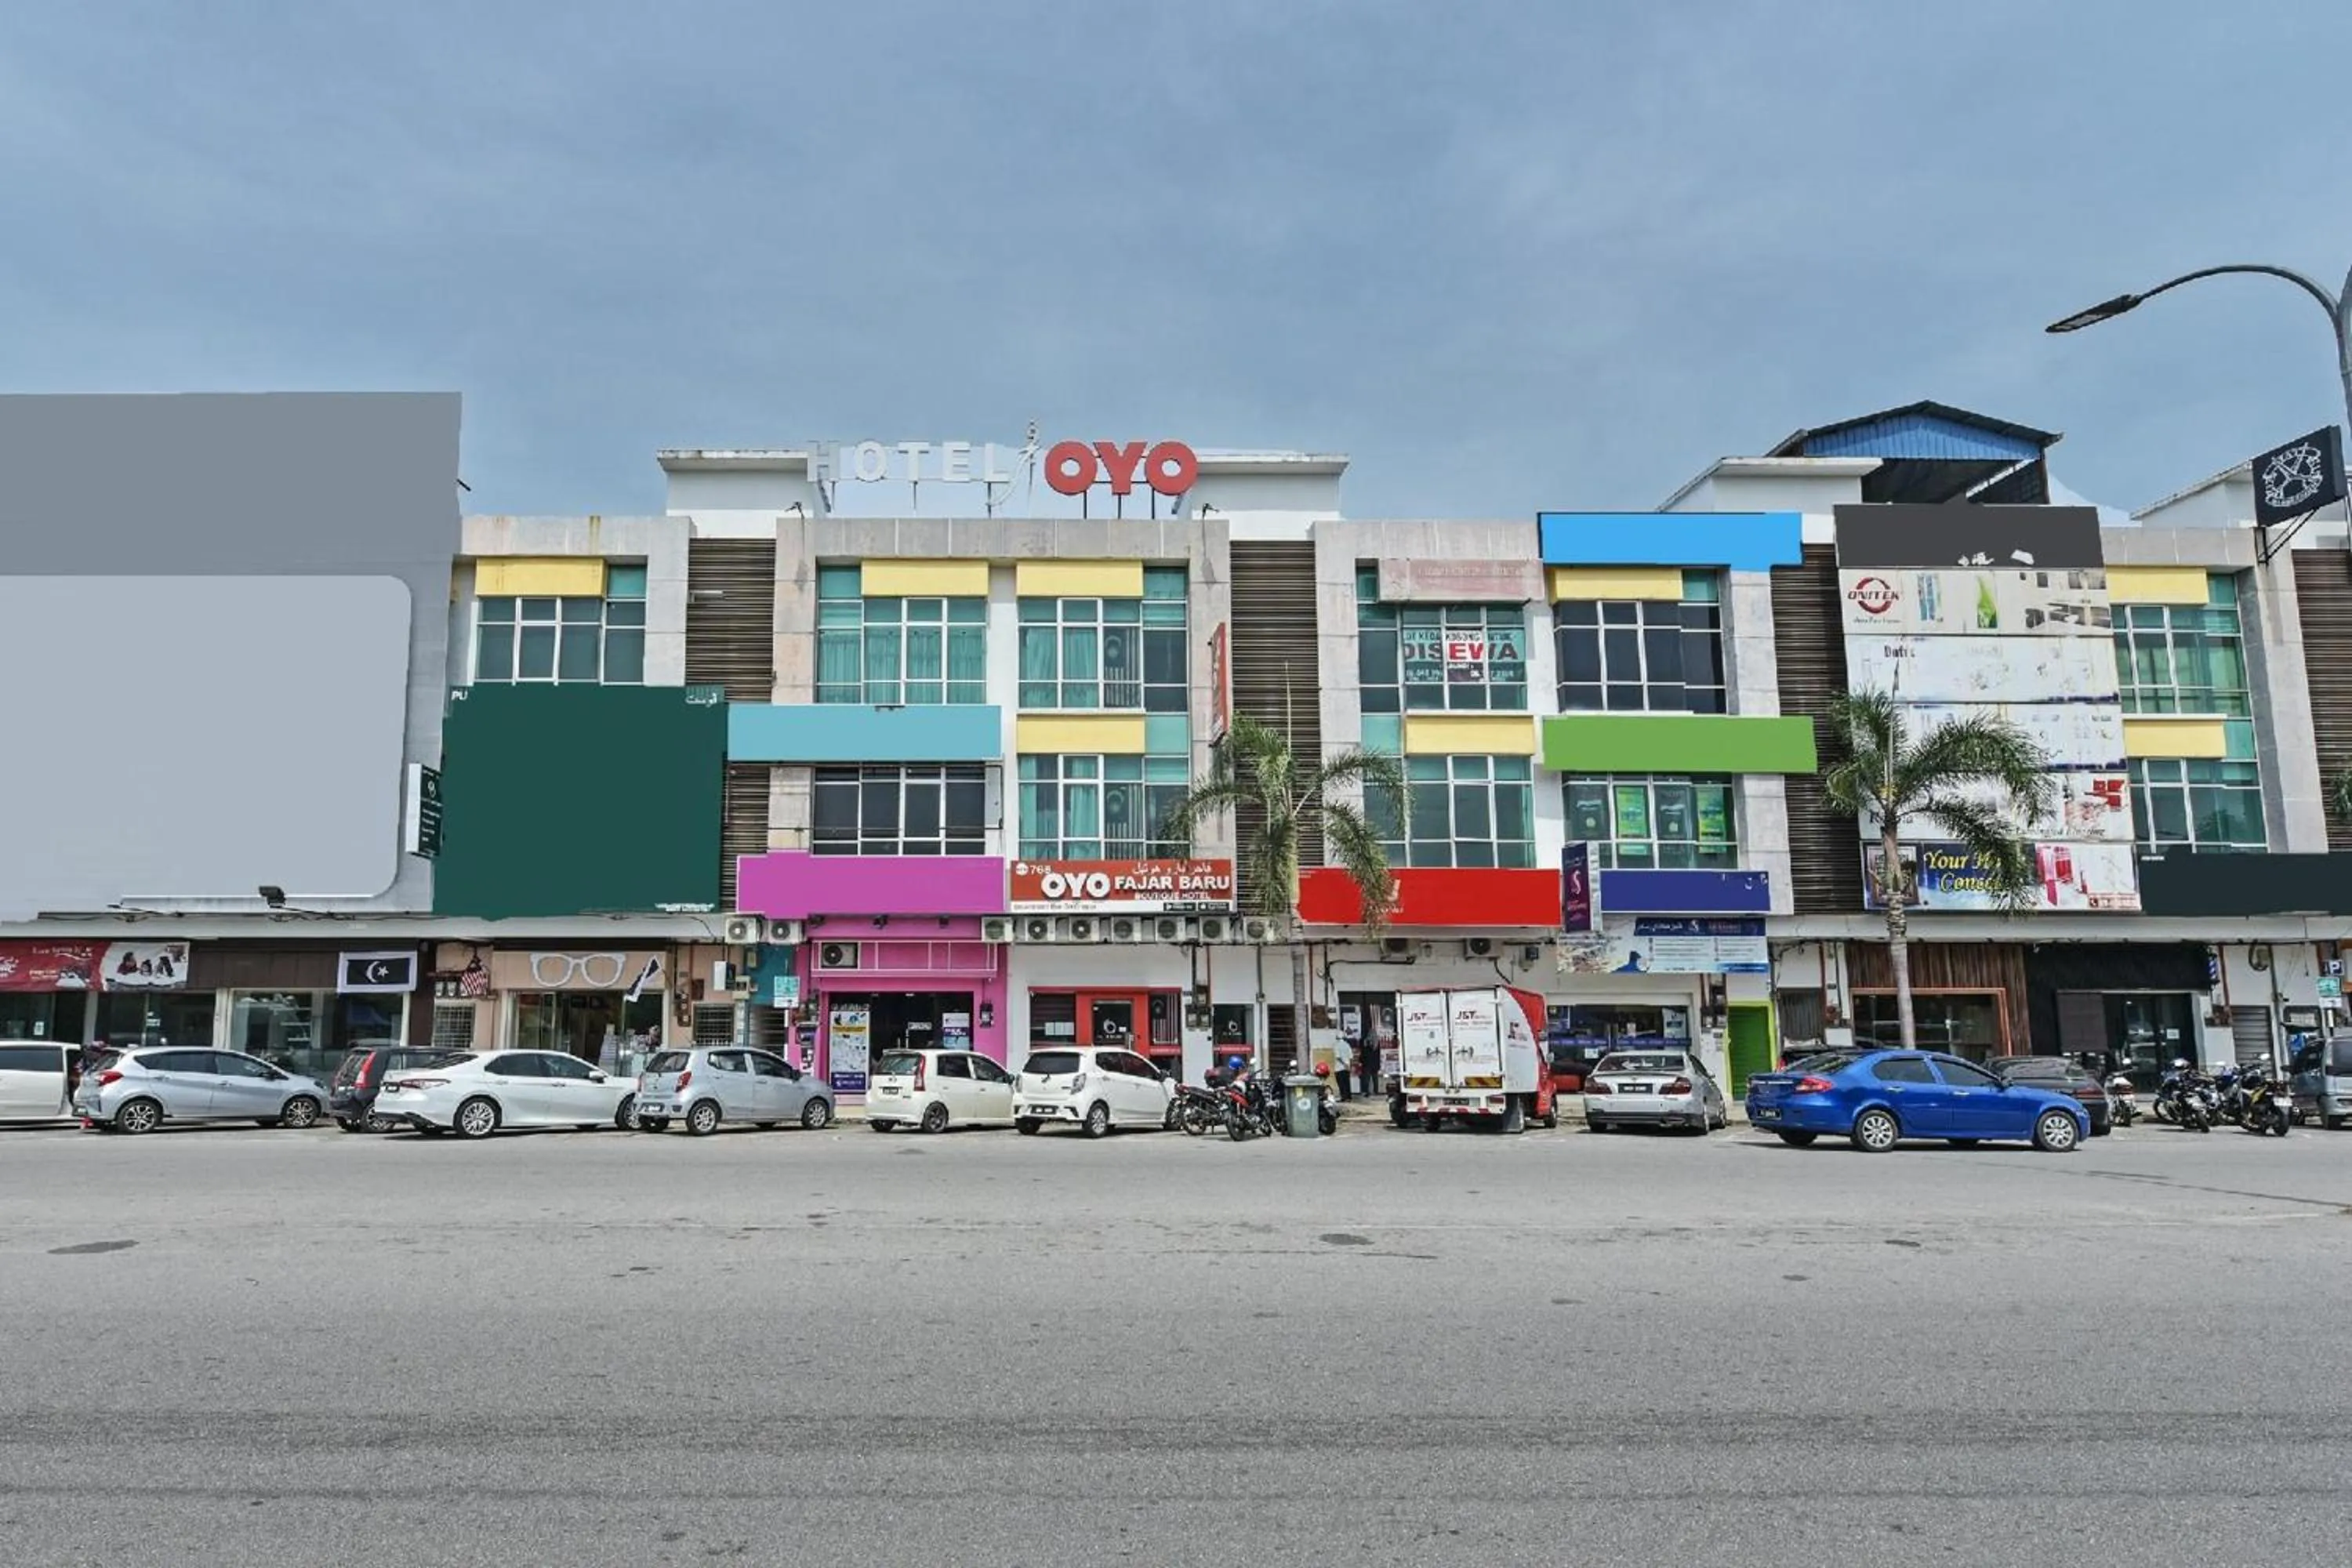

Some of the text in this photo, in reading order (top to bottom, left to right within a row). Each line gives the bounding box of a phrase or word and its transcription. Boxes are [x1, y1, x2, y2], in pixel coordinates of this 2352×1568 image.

[807, 440, 1198, 495] HOTEL OYO
[1404, 642, 1519, 660] DISEWA
[1923, 849, 1969, 869] Your
[1041, 872, 1111, 898] OYO
[1114, 876, 1230, 890] FAJAR BARU
[1181, 891, 1210, 900] HOTEL
